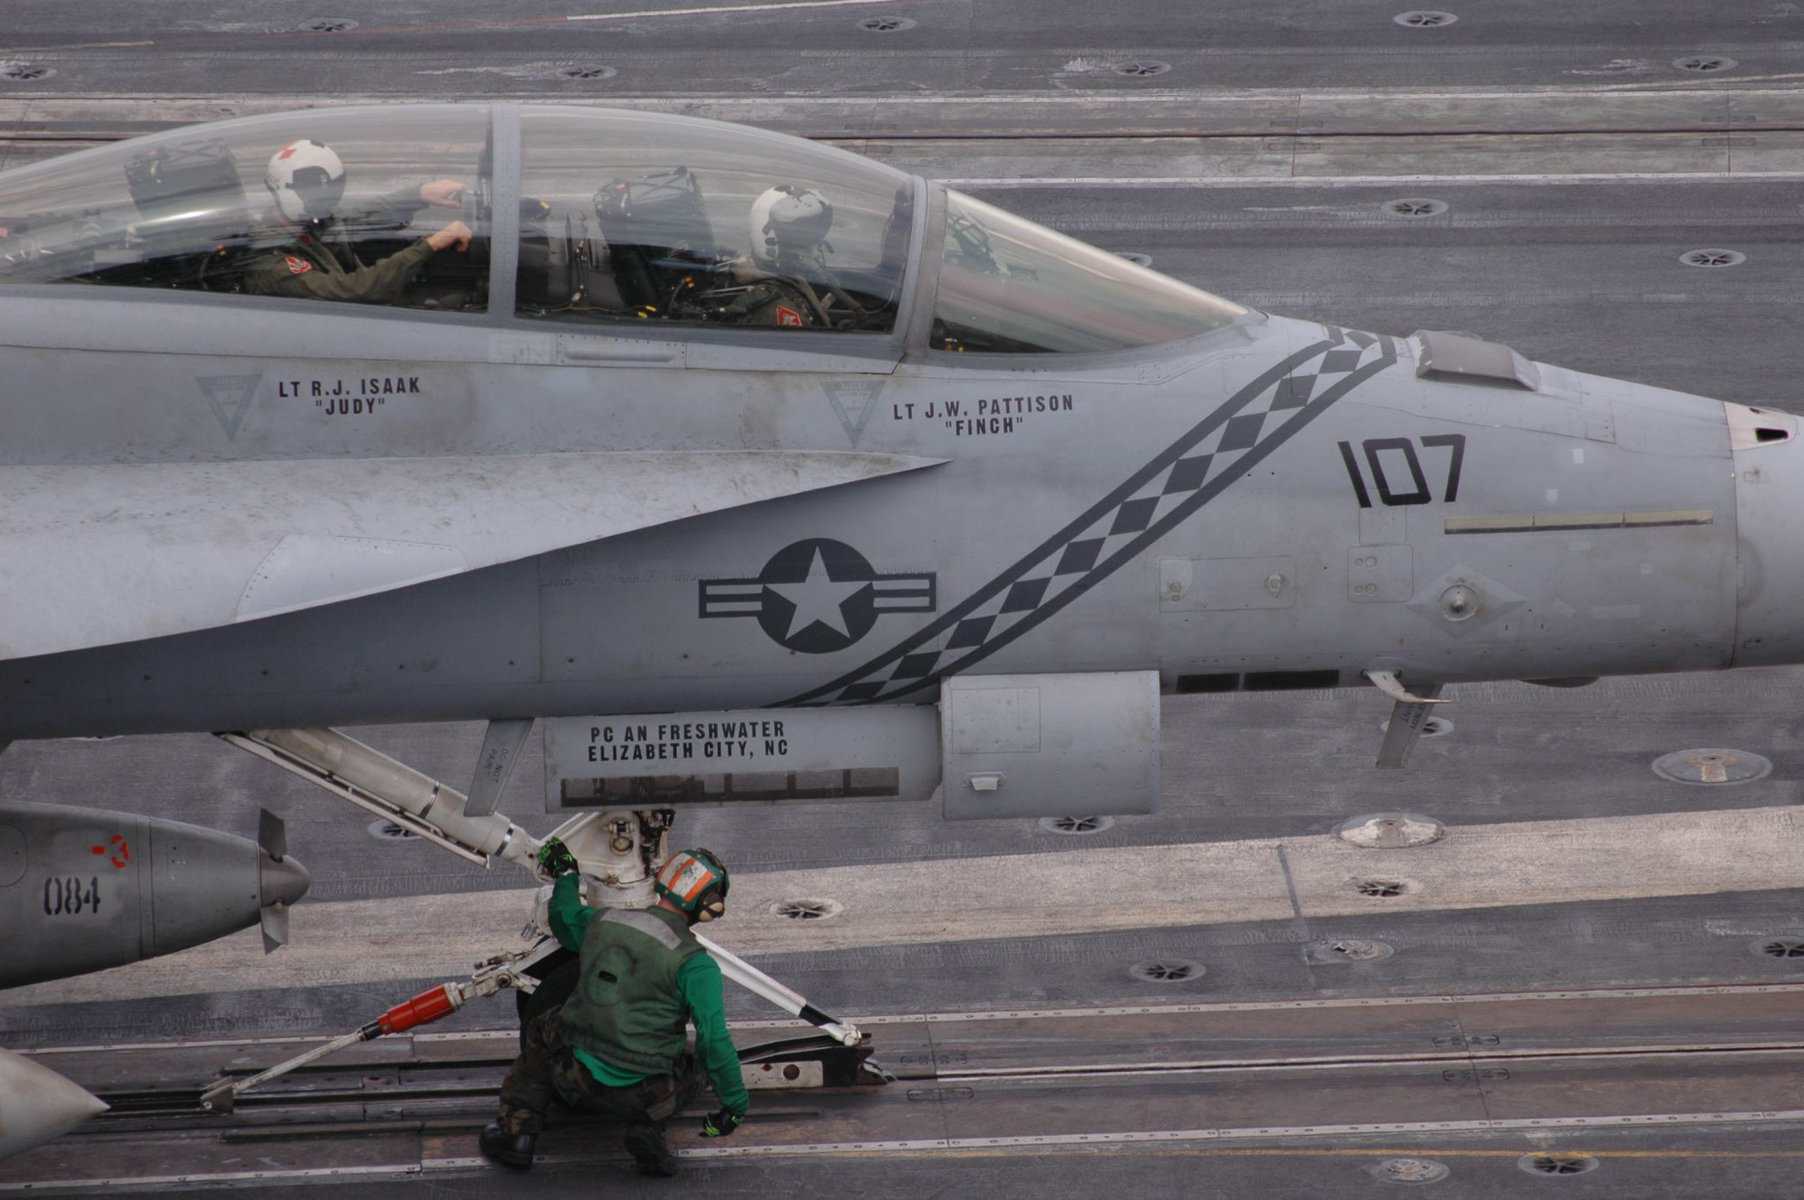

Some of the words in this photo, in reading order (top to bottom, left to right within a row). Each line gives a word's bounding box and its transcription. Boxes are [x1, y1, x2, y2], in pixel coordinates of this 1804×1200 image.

[279, 381, 300, 398] LT
[312, 380, 350, 397] R.J.
[361, 377, 420, 395] ISAAK
[316, 398, 385, 415] "JUDY"
[893, 403, 915, 420] LT
[925, 401, 968, 419] J.W.
[978, 395, 1073, 416] PATTISON
[946, 417, 1023, 436] "FINCH"
[1337, 434, 1466, 508] 107
[591, 726, 614, 743] PC
[624, 726, 648, 743] AN
[658, 721, 784, 741] FRESHWATER
[588, 742, 693, 762] ELIZABETH
[704, 740, 754, 760] CITY,
[765, 739, 788, 756] NC
[44, 876, 101, 916] 084
